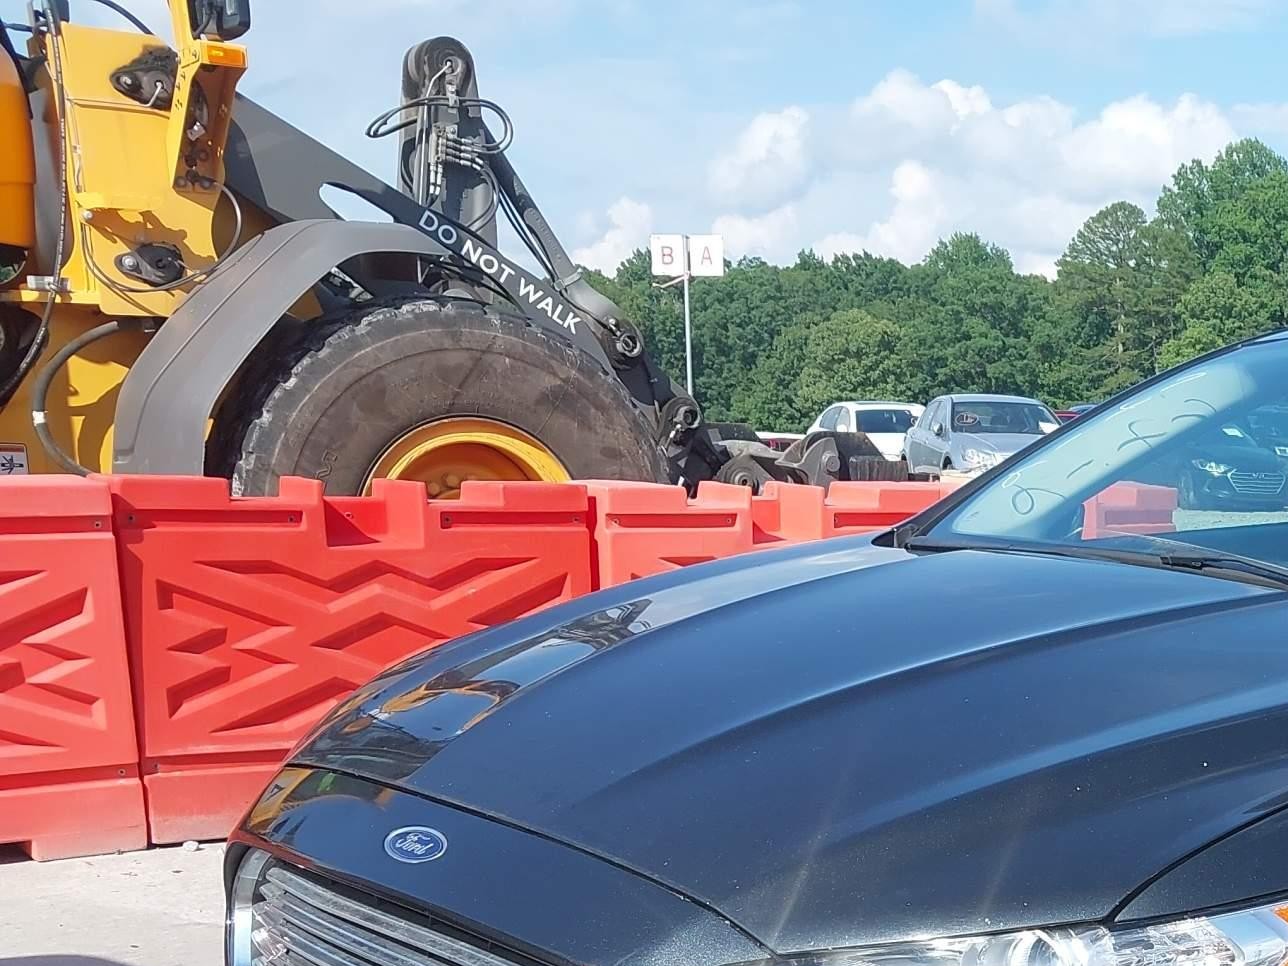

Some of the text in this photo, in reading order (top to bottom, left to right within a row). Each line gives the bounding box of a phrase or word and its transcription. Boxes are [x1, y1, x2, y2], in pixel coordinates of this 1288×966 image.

[660, 245, 675, 266] B
[700, 245, 713, 266] A
[418, 209, 582, 335] DO NOT WALK
[394, 832, 434, 855] Ford
